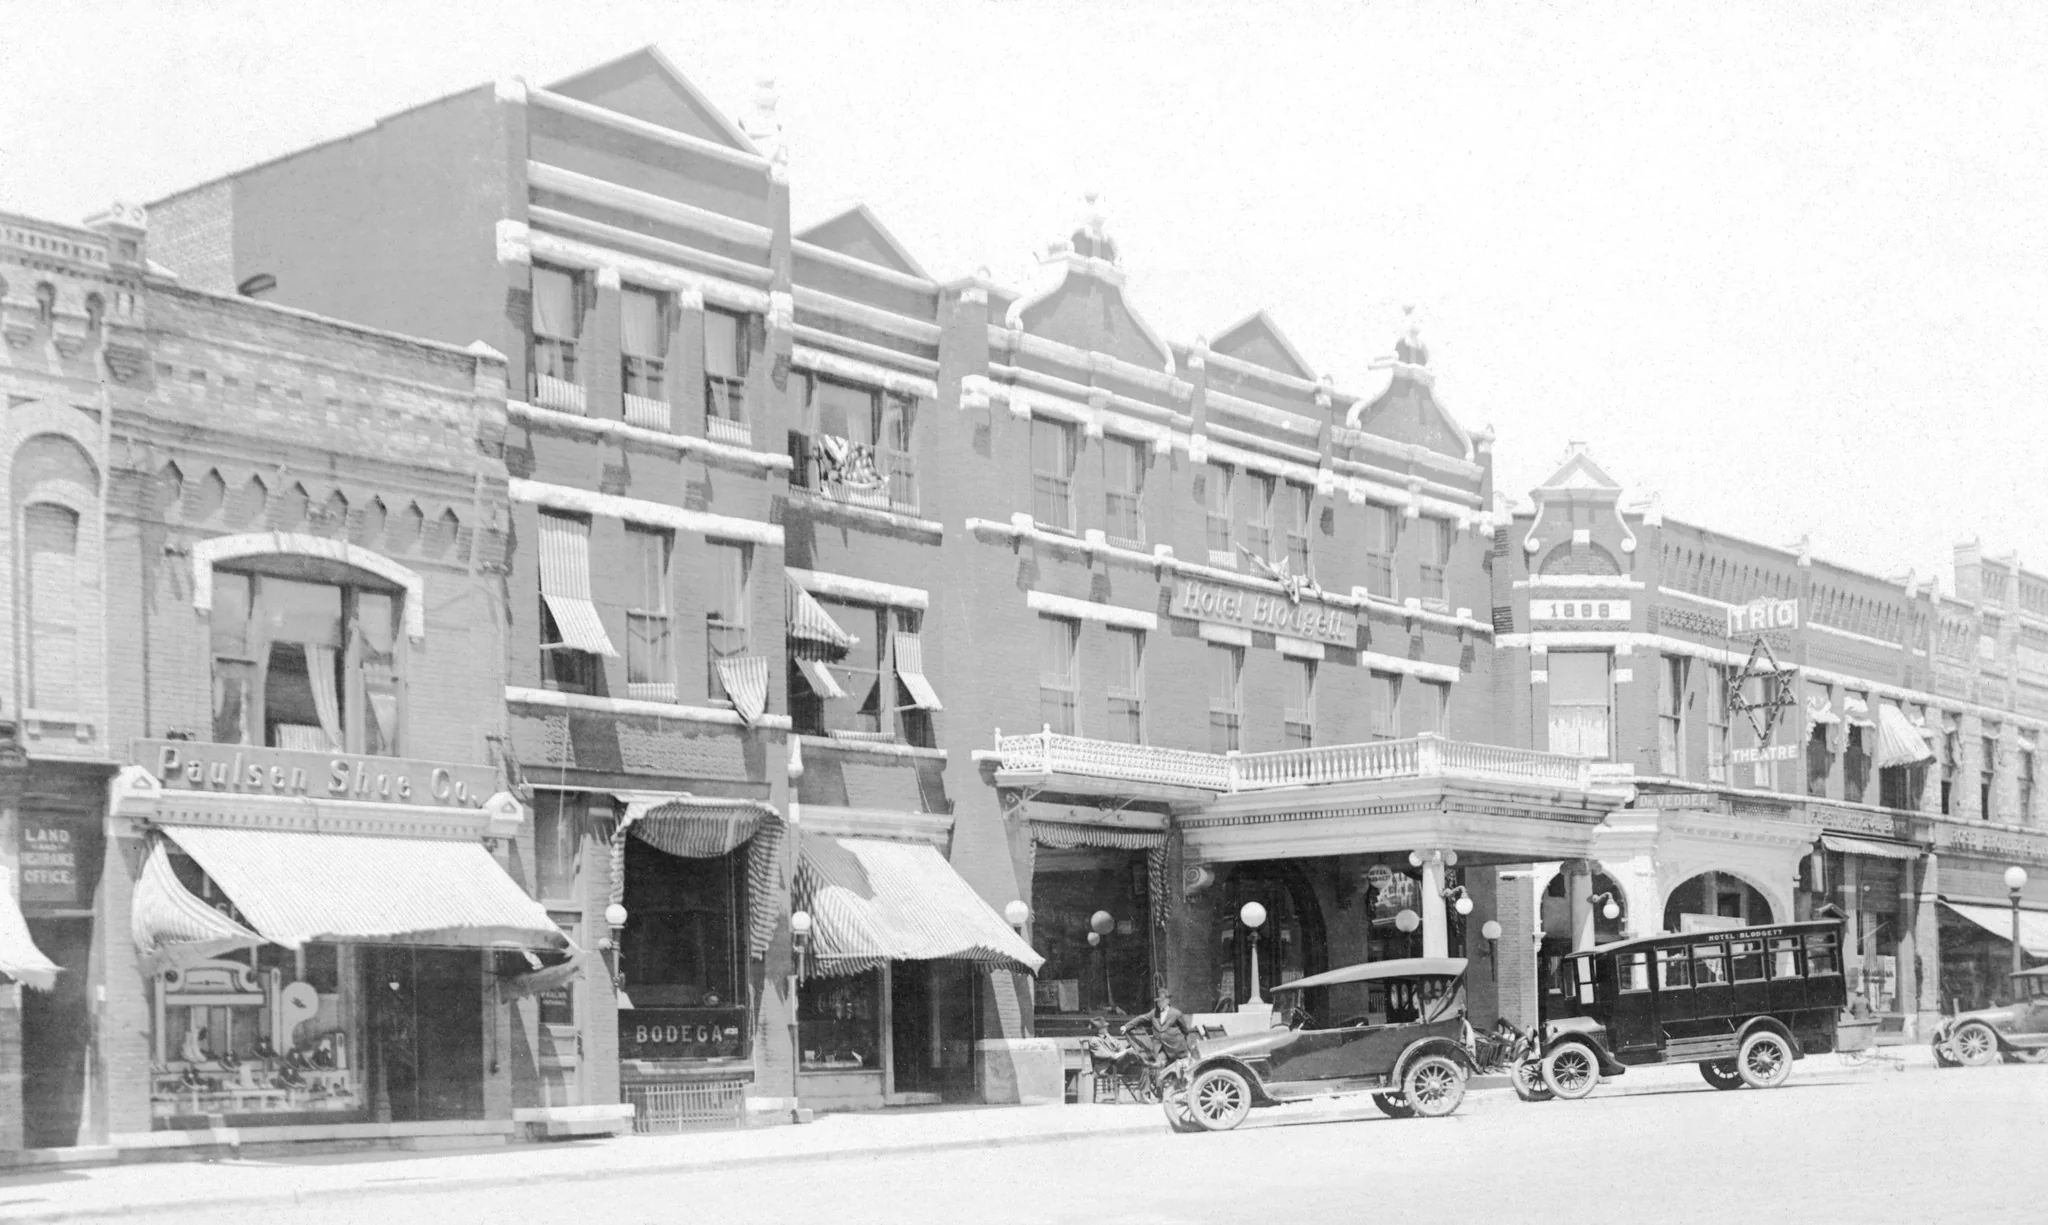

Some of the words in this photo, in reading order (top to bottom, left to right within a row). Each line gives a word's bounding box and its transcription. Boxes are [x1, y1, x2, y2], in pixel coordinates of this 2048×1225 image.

[1183, 581, 1245, 621] Hotel
[1550, 602, 1610, 618] 1888
[1731, 602, 1794, 631] TRIO
[1732, 744, 1798, 763] THEATRE
[157, 745, 308, 792] Paulsen
[327, 759, 412, 800] Shoe
[24, 828, 71, 843] LAND
[1708, 933, 1736, 942] HOTEL
[1739, 928, 1784, 940] BLODGETT
[636, 1024, 723, 1043] BODEGA
